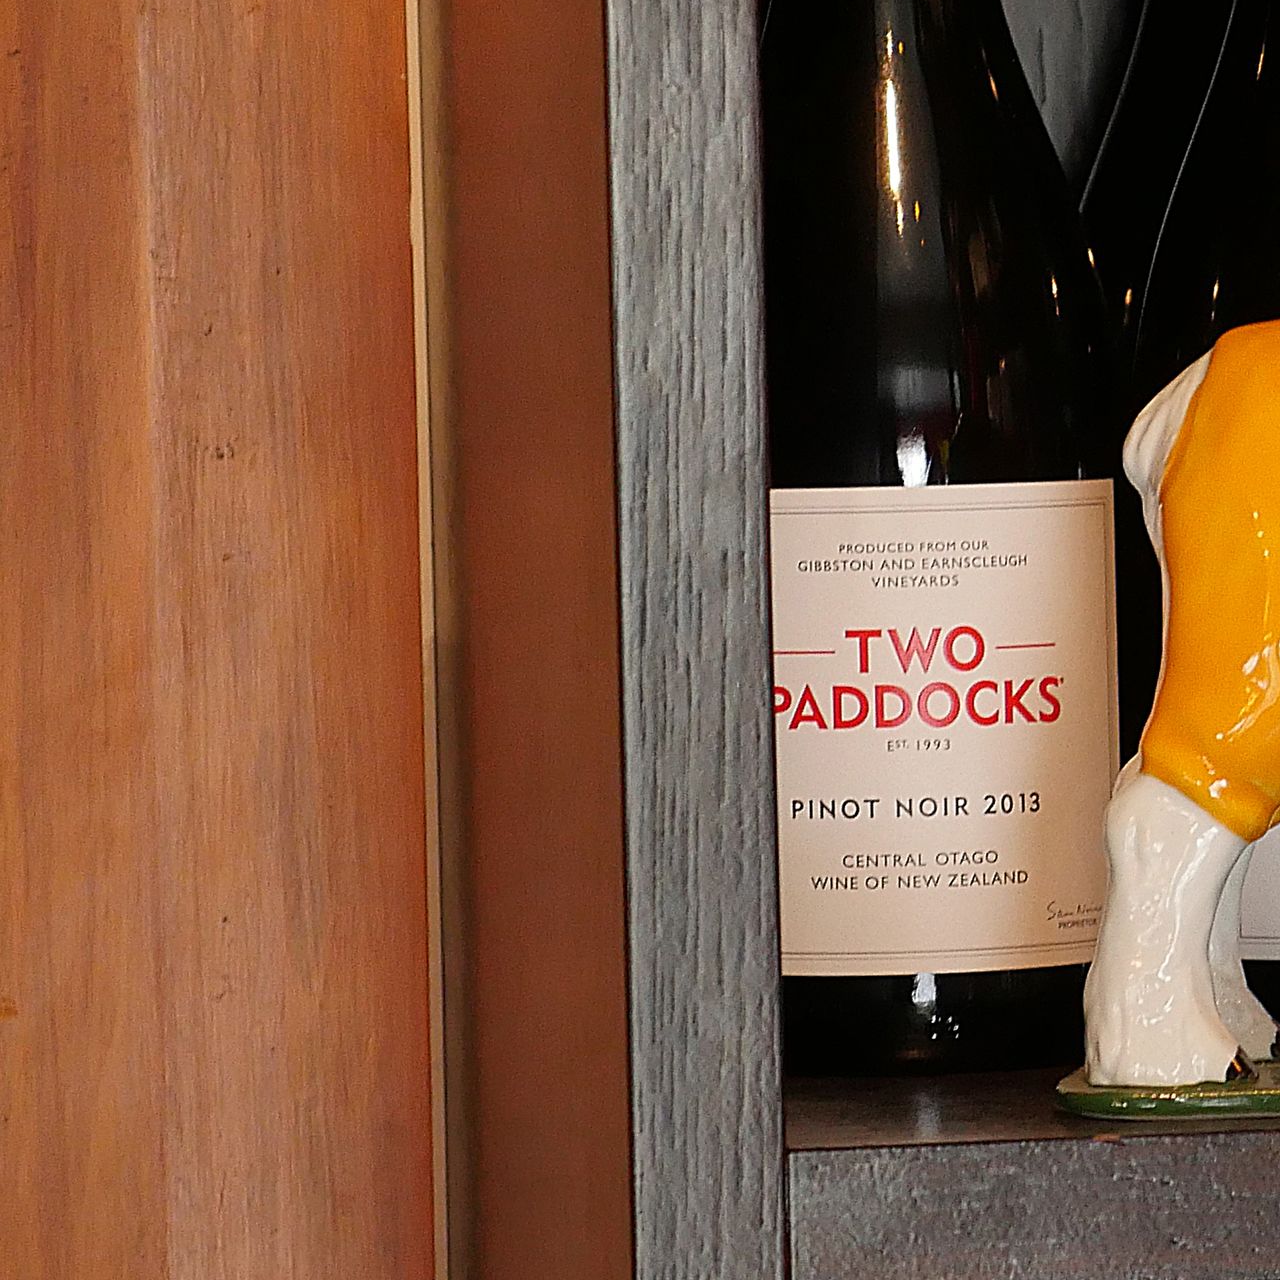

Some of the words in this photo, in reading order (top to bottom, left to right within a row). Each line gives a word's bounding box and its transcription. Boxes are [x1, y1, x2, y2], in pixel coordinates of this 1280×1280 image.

[838, 542, 914, 555] PRODUCED
[919, 541, 956, 552] FROM
[960, 540, 989, 551] OUR
[797, 559, 874, 573] GIBBSTON
[880, 558, 915, 570] AND
[921, 555, 1028, 570] EARNSCLEUGH
[871, 575, 959, 588] VINEYARDS
[845, 625, 985, 674] TWO
[915, 738, 951, 751] 1993
[792, 799, 880, 819] PINOT
[896, 796, 969, 818] NOIR
[984, 792, 1041, 815] 2013
[842, 852, 926, 869] CENTRAL
[935, 850, 999, 866] OTAGO
[811, 876, 858, 891] WINE
[865, 875, 889, 890] OF
[898, 874, 941, 889] NEW
[949, 870, 1028, 887] ZEALAND
